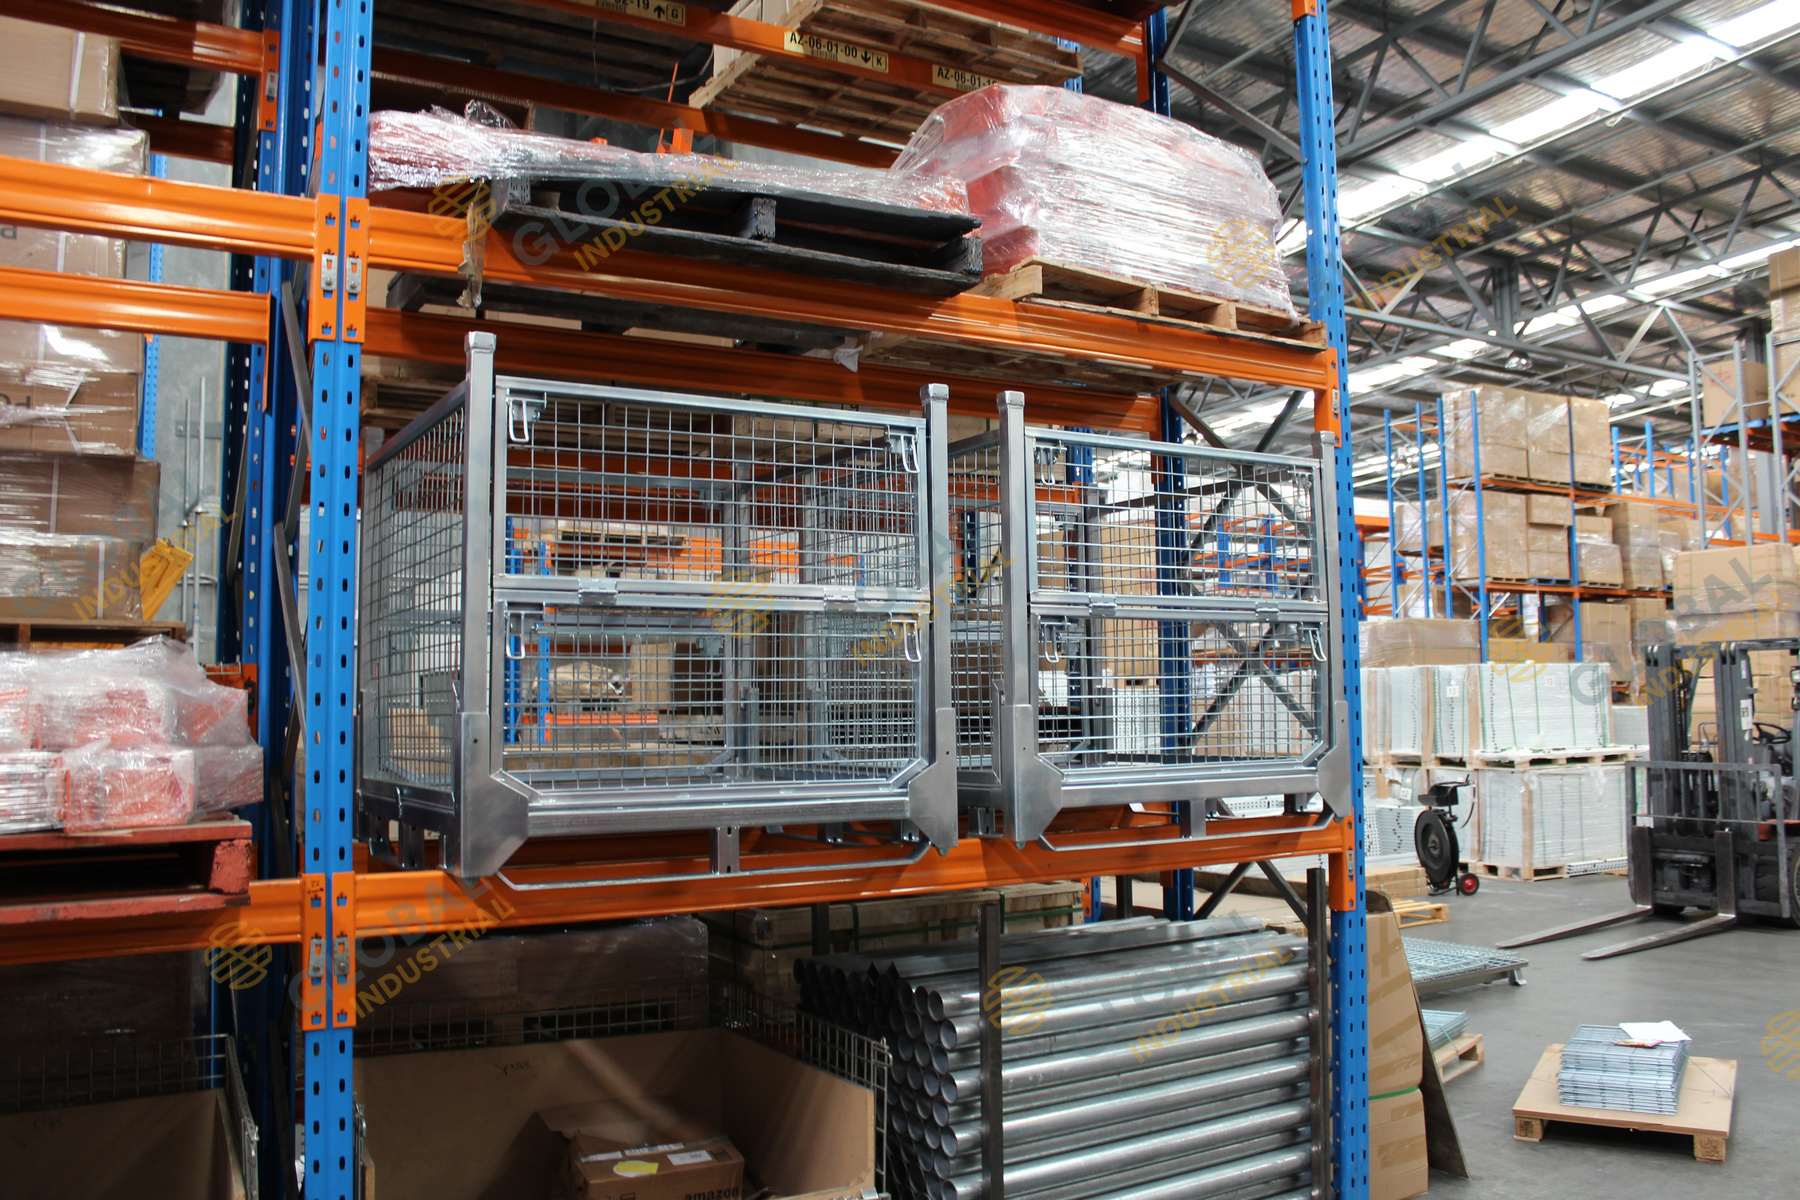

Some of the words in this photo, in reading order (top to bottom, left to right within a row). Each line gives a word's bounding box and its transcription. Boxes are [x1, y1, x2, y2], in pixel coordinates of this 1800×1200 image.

[671, 8, 679, 19] G
[789, 32, 858, 58] AZ-06-01-00
[876, 56, 883, 67] K
[937, 66, 998, 88] AZ-06-01-1
[684, 1187, 739, 1200] amazon
